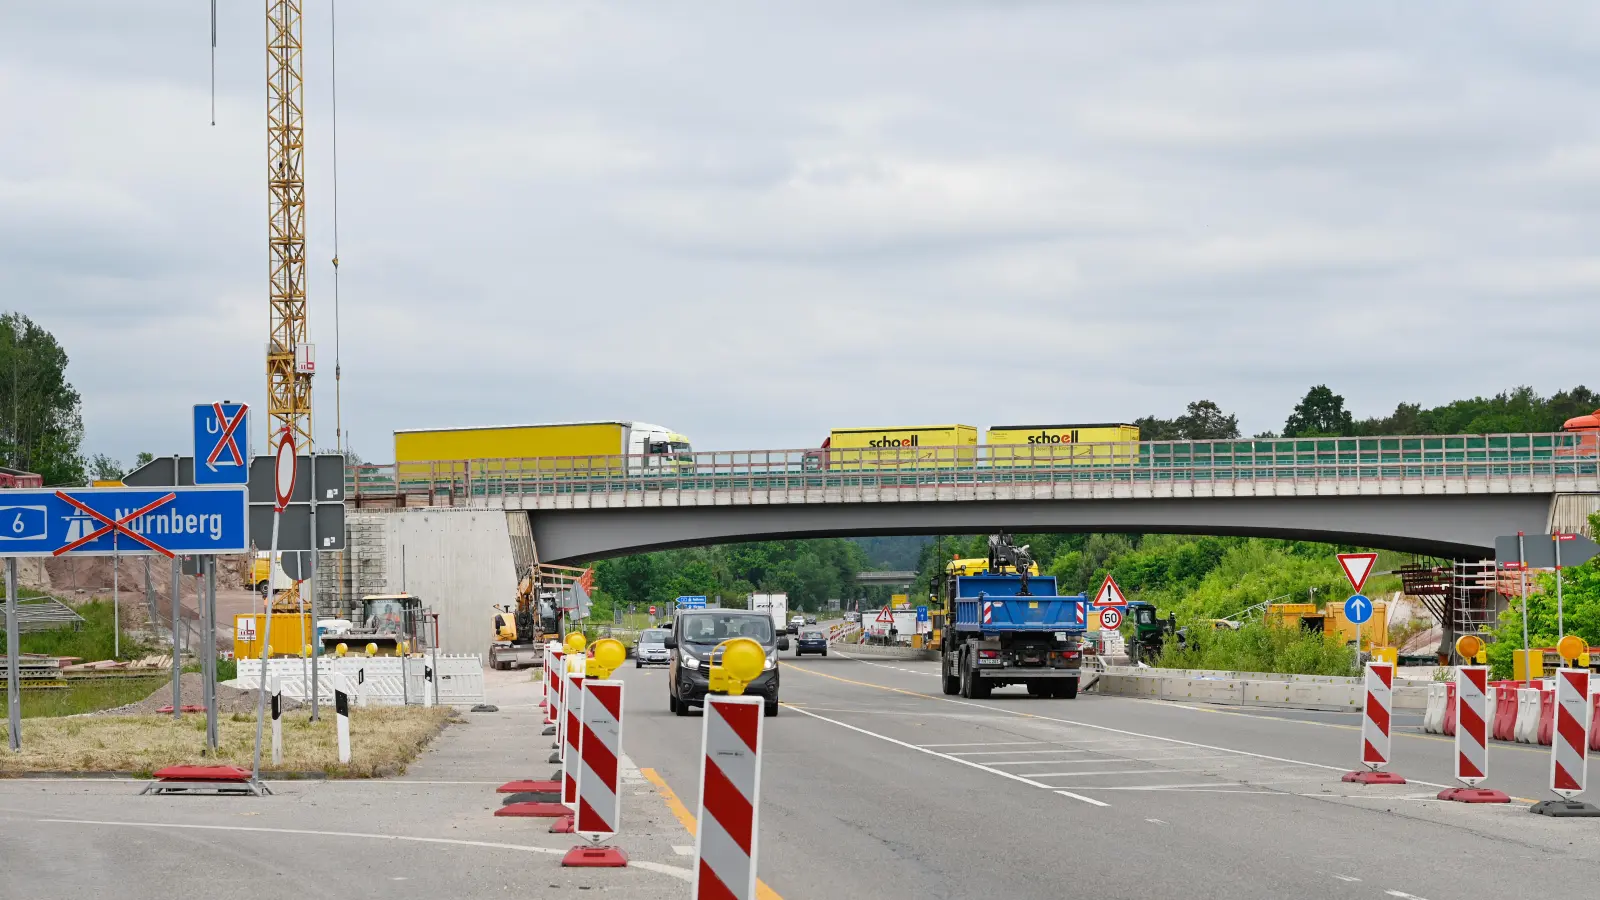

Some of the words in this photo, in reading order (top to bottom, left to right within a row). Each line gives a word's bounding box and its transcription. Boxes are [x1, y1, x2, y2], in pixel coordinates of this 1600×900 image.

[206, 416, 234, 434] U
[869, 434, 918, 448] schoell
[1027, 429, 1079, 444] schoell
[12, 512, 25, 533] 6
[115, 507, 222, 540] Nürnberg
[1104, 613, 1117, 624] 50
